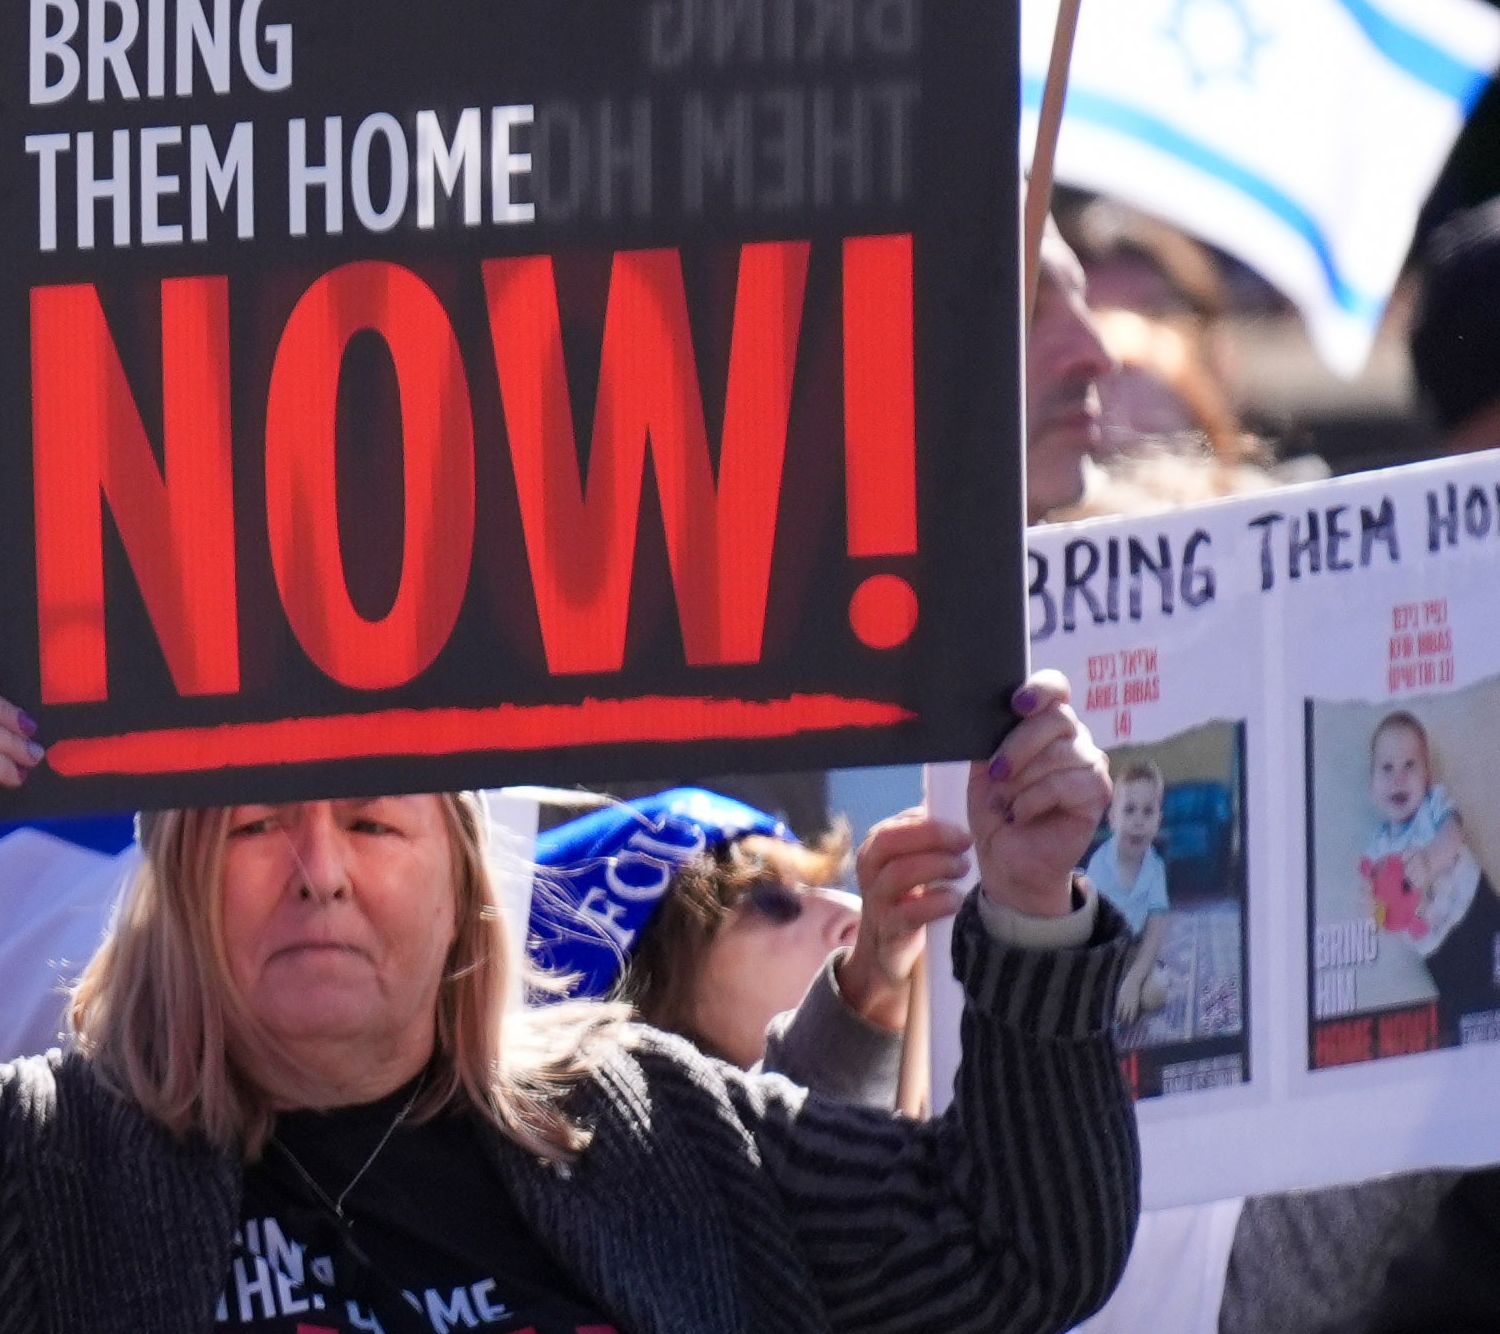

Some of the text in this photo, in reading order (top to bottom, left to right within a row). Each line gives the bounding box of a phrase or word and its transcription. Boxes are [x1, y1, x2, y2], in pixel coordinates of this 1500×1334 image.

[26, 103, 536, 252] THEM HOME
[28, 233, 919, 705] NOW!
[1028, 481, 1500, 641] BRING THEM HO
